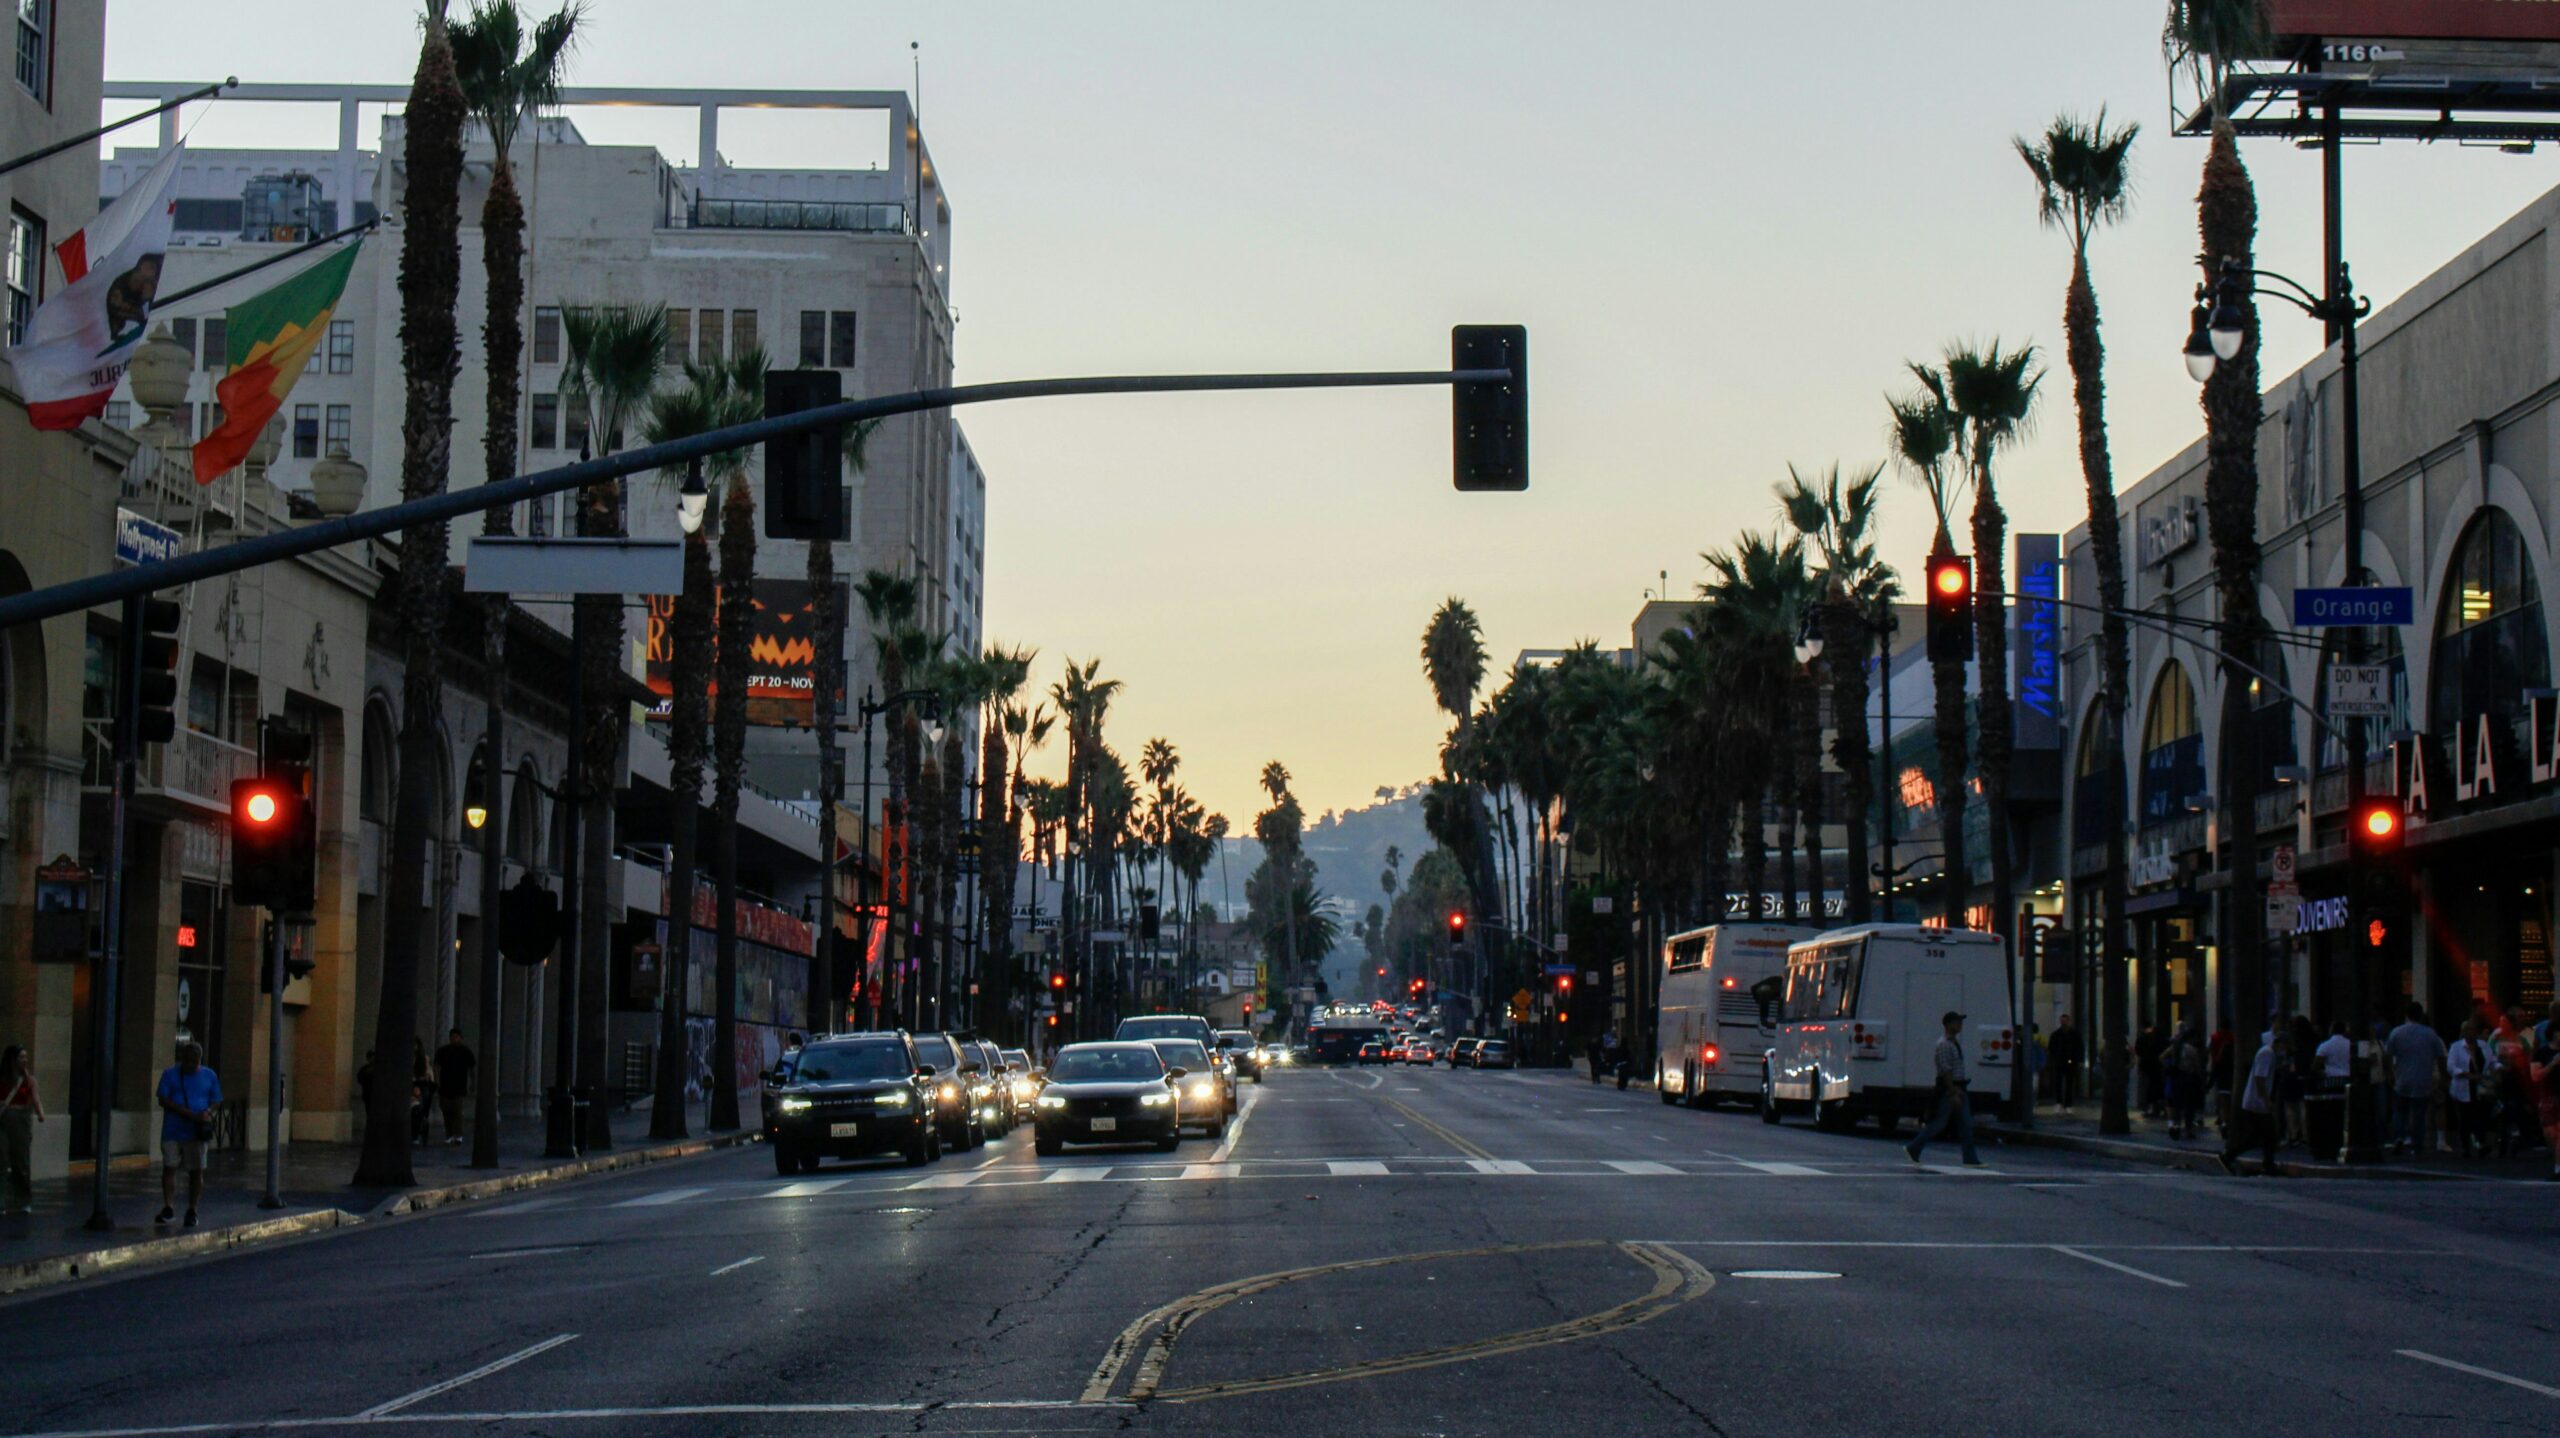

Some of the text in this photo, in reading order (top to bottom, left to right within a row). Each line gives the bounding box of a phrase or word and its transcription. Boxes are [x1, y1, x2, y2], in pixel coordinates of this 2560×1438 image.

[120, 520, 167, 562] Hollywood
[2313, 598, 2394, 621] Orange
[2022, 561, 2055, 718] Marshalls
[768, 676, 781, 688] 20
[2335, 668, 2380, 684] DO NOT
[2456, 713, 2496, 802] LA
